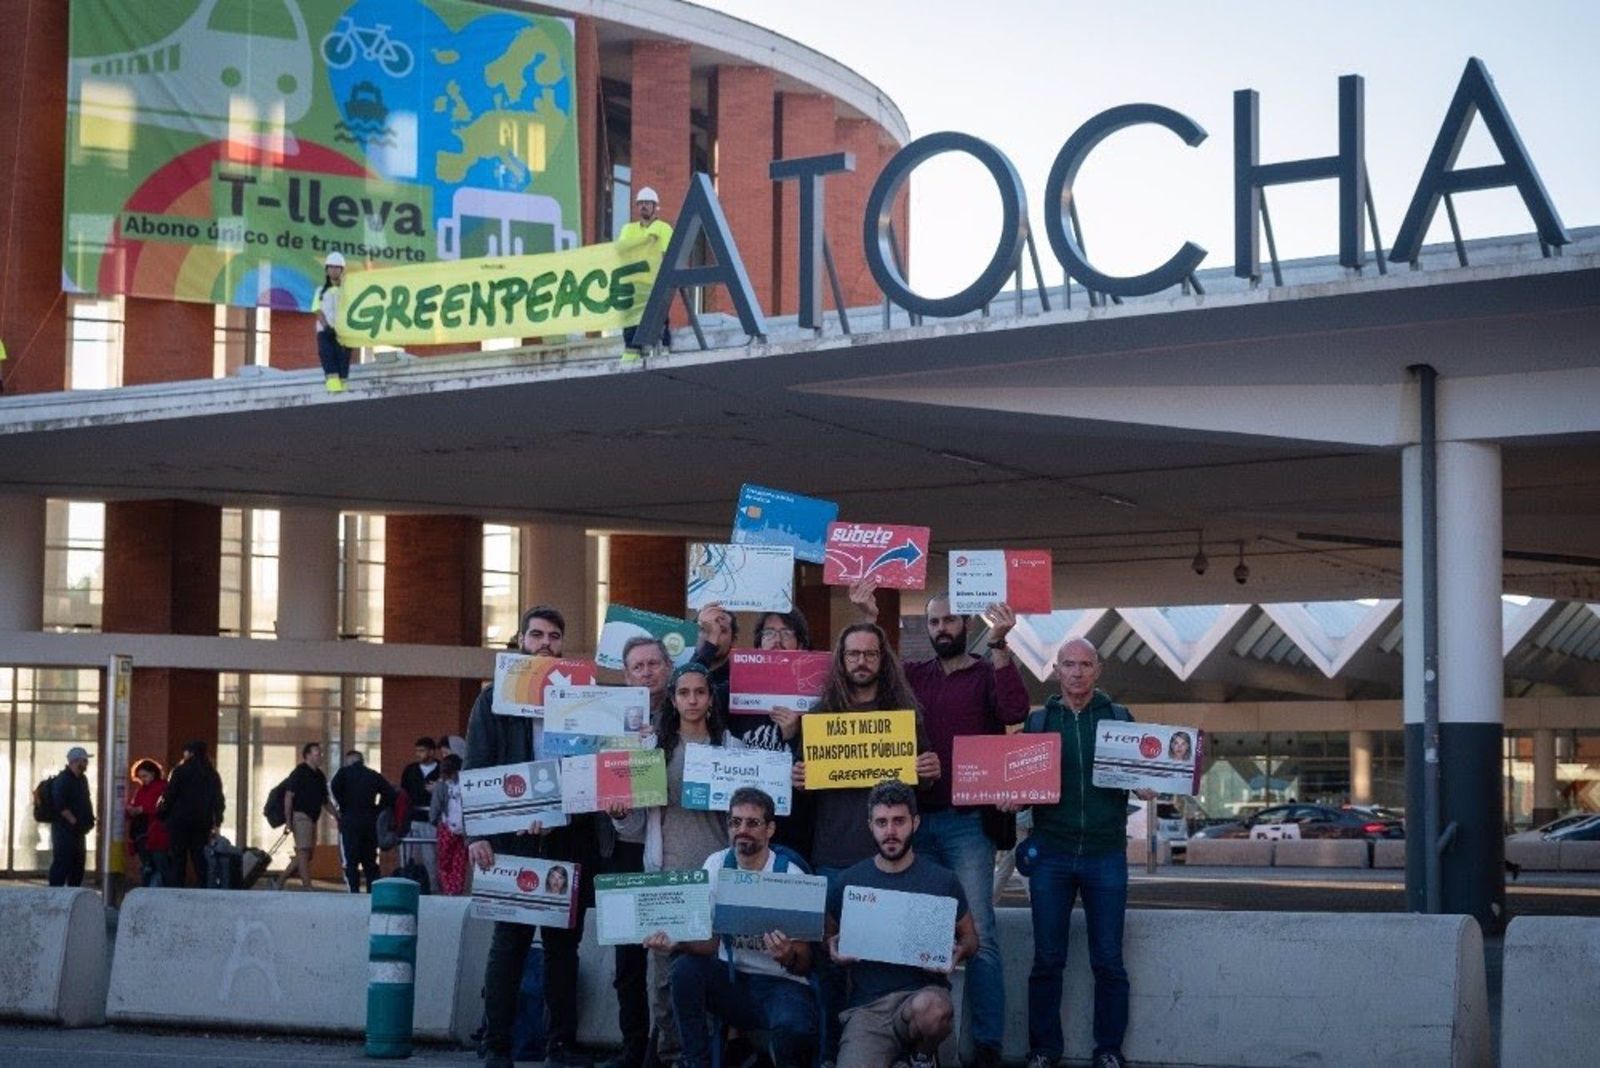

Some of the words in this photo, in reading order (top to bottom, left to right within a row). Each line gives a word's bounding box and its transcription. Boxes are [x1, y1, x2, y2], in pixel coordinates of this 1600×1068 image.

[218, 173, 425, 237] T-lleva
[632, 57, 1571, 346] ATOCHA
[124, 215, 200, 239] Abono
[207, 222, 269, 245] único
[276, 230, 304, 249] de
[311, 235, 425, 262] transporte
[346, 260, 651, 339] GREENPEACE
[826, 717, 848, 736] MÁS
[849, 719, 857, 735] Y
[859, 718, 892, 734] MEJOR
[806, 742, 869, 761] TRANSPORTE
[871, 739, 914, 758] PÚBLICO
[711, 761, 760, 777] T-usual
[828, 768, 903, 782] GREENPEACE
